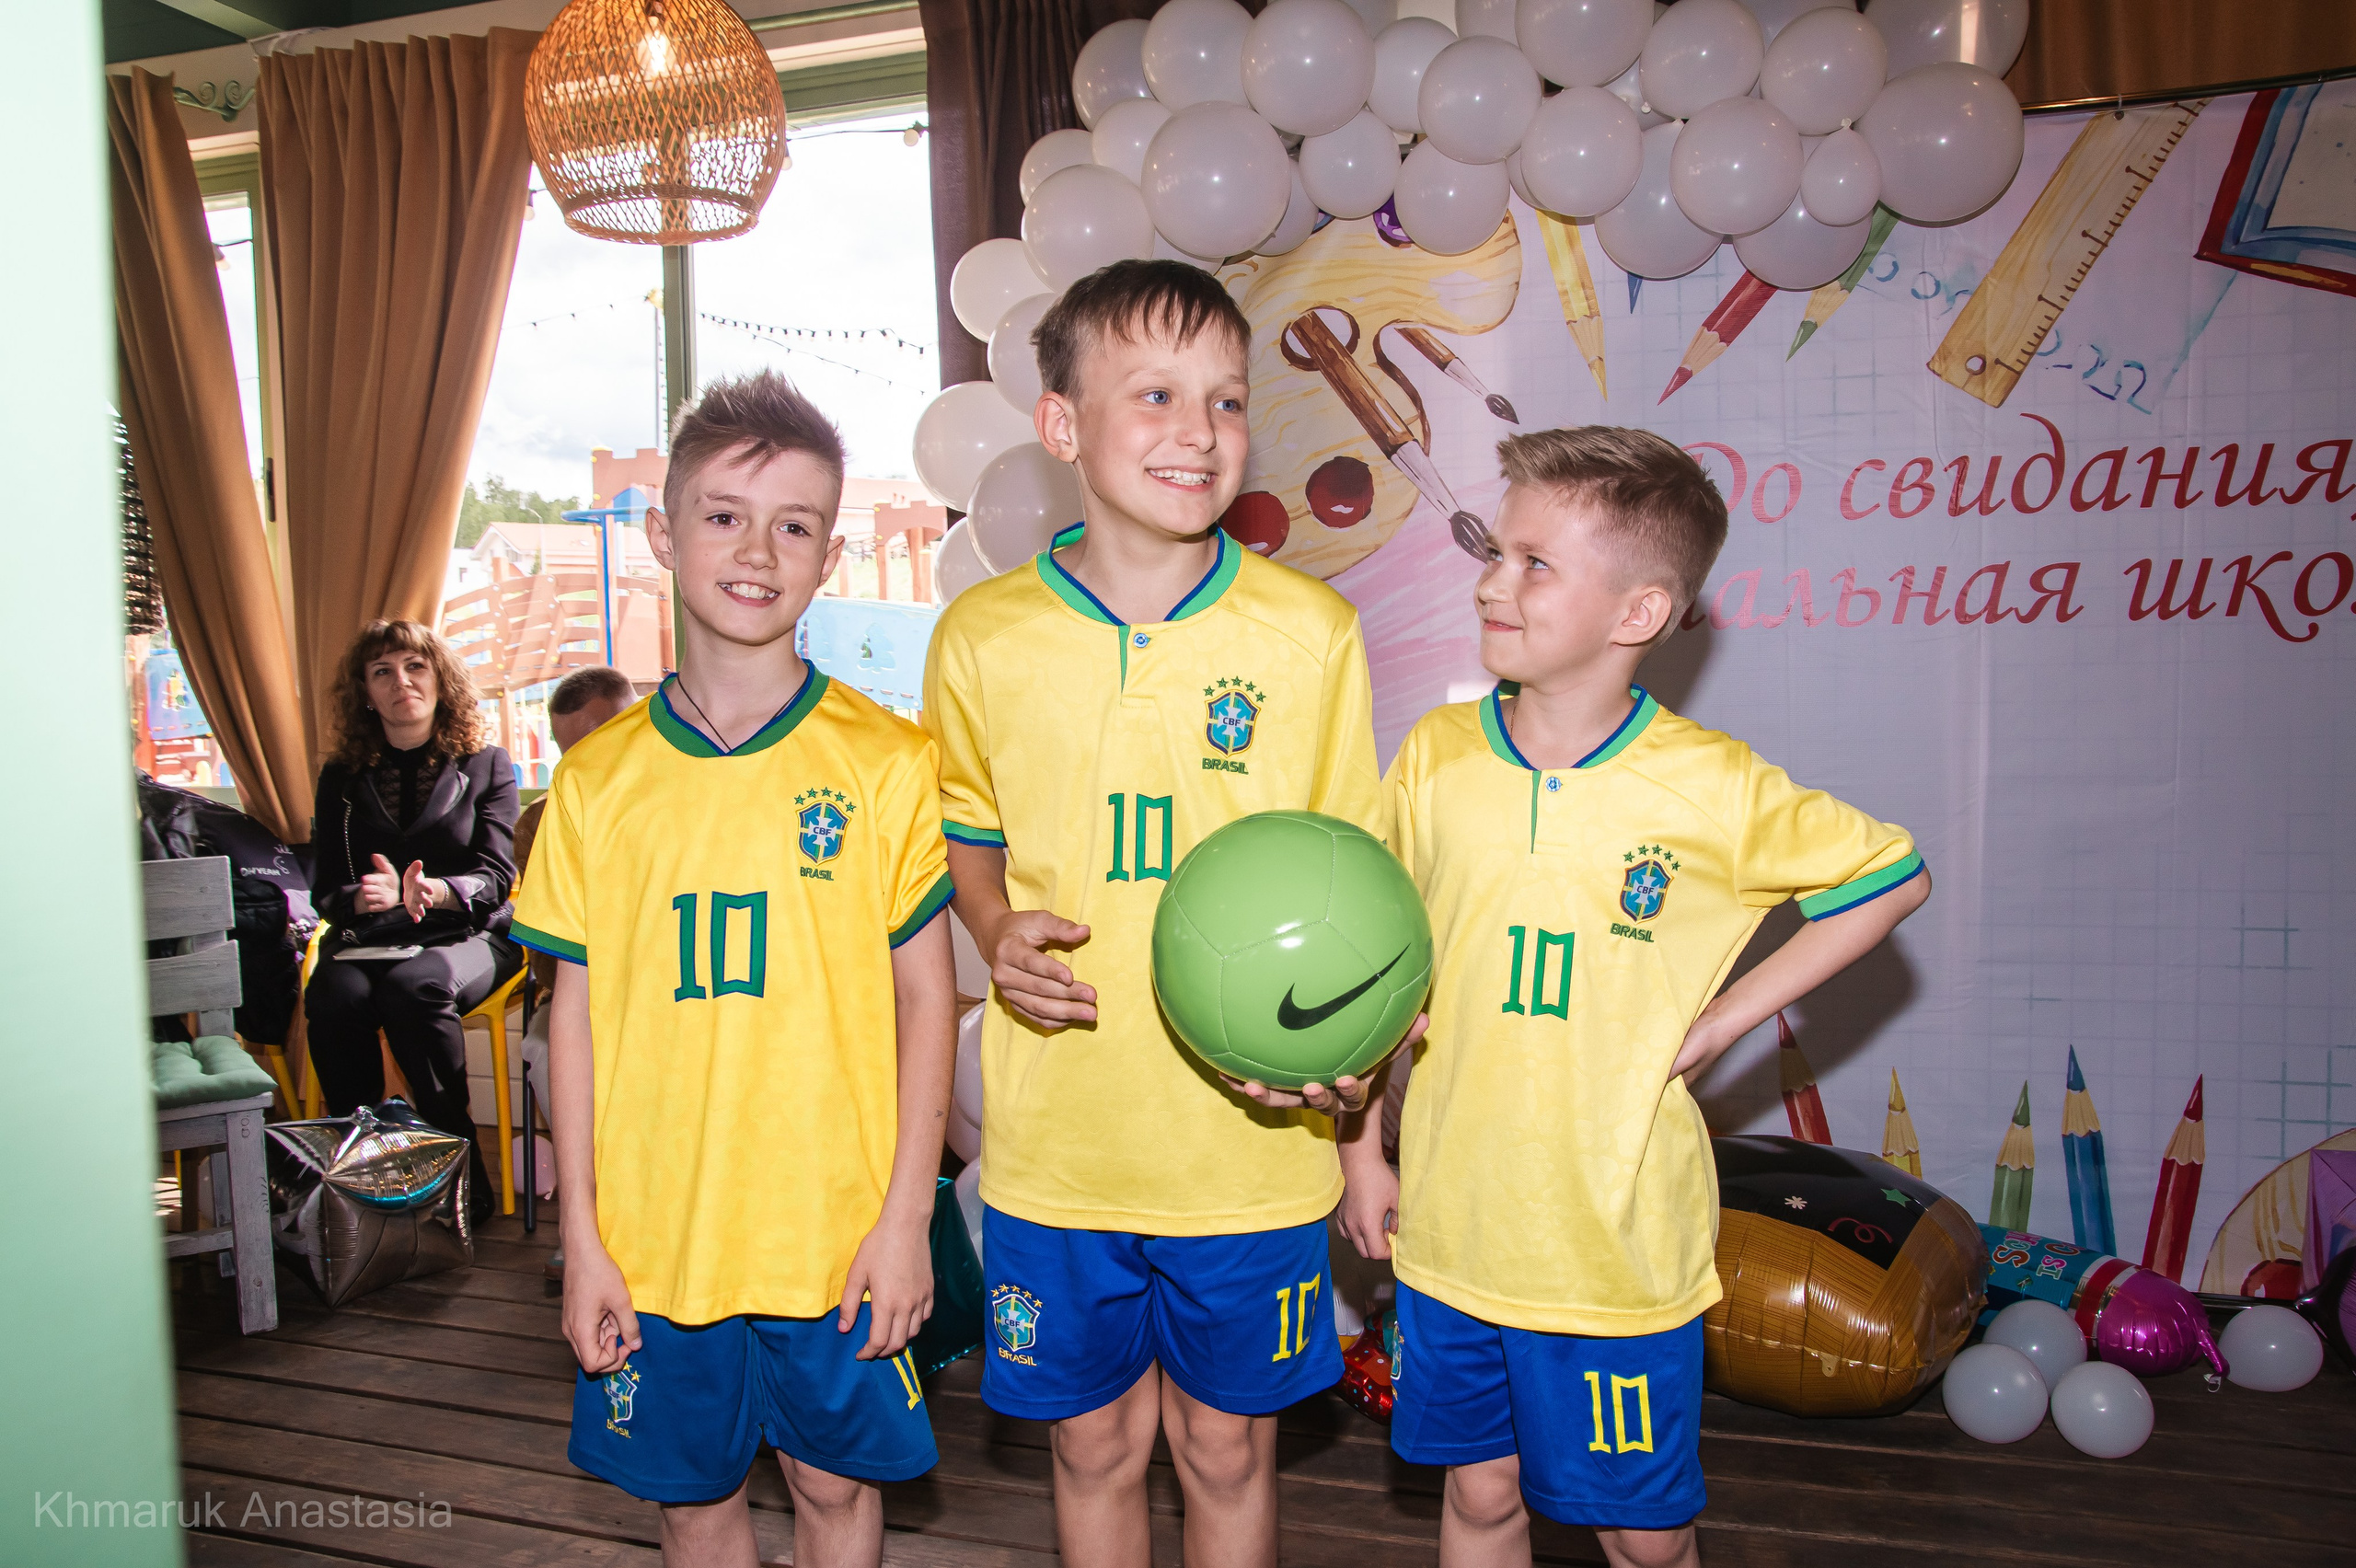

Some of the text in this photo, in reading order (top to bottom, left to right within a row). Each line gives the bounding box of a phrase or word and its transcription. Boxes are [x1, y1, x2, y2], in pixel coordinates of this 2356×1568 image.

[1839, 411, 2356, 522] свидания
[2123, 550, 2356, 643] шко
[1222, 717, 1242, 727] CBF
[1202, 757, 1249, 775] BRASIL
[813, 826, 832, 836] CBF
[1106, 792, 1173, 882] 10
[800, 866, 834, 881] BRASIL
[1636, 885, 1655, 895] CBF
[1610, 922, 1655, 943] BRASIL
[673, 890, 768, 1002] 10
[1502, 925, 1575, 1021] 10
[1004, 1318, 1021, 1328] CBF
[999, 1346, 1037, 1366] BRASIL
[1584, 1371, 1654, 1454] 10
